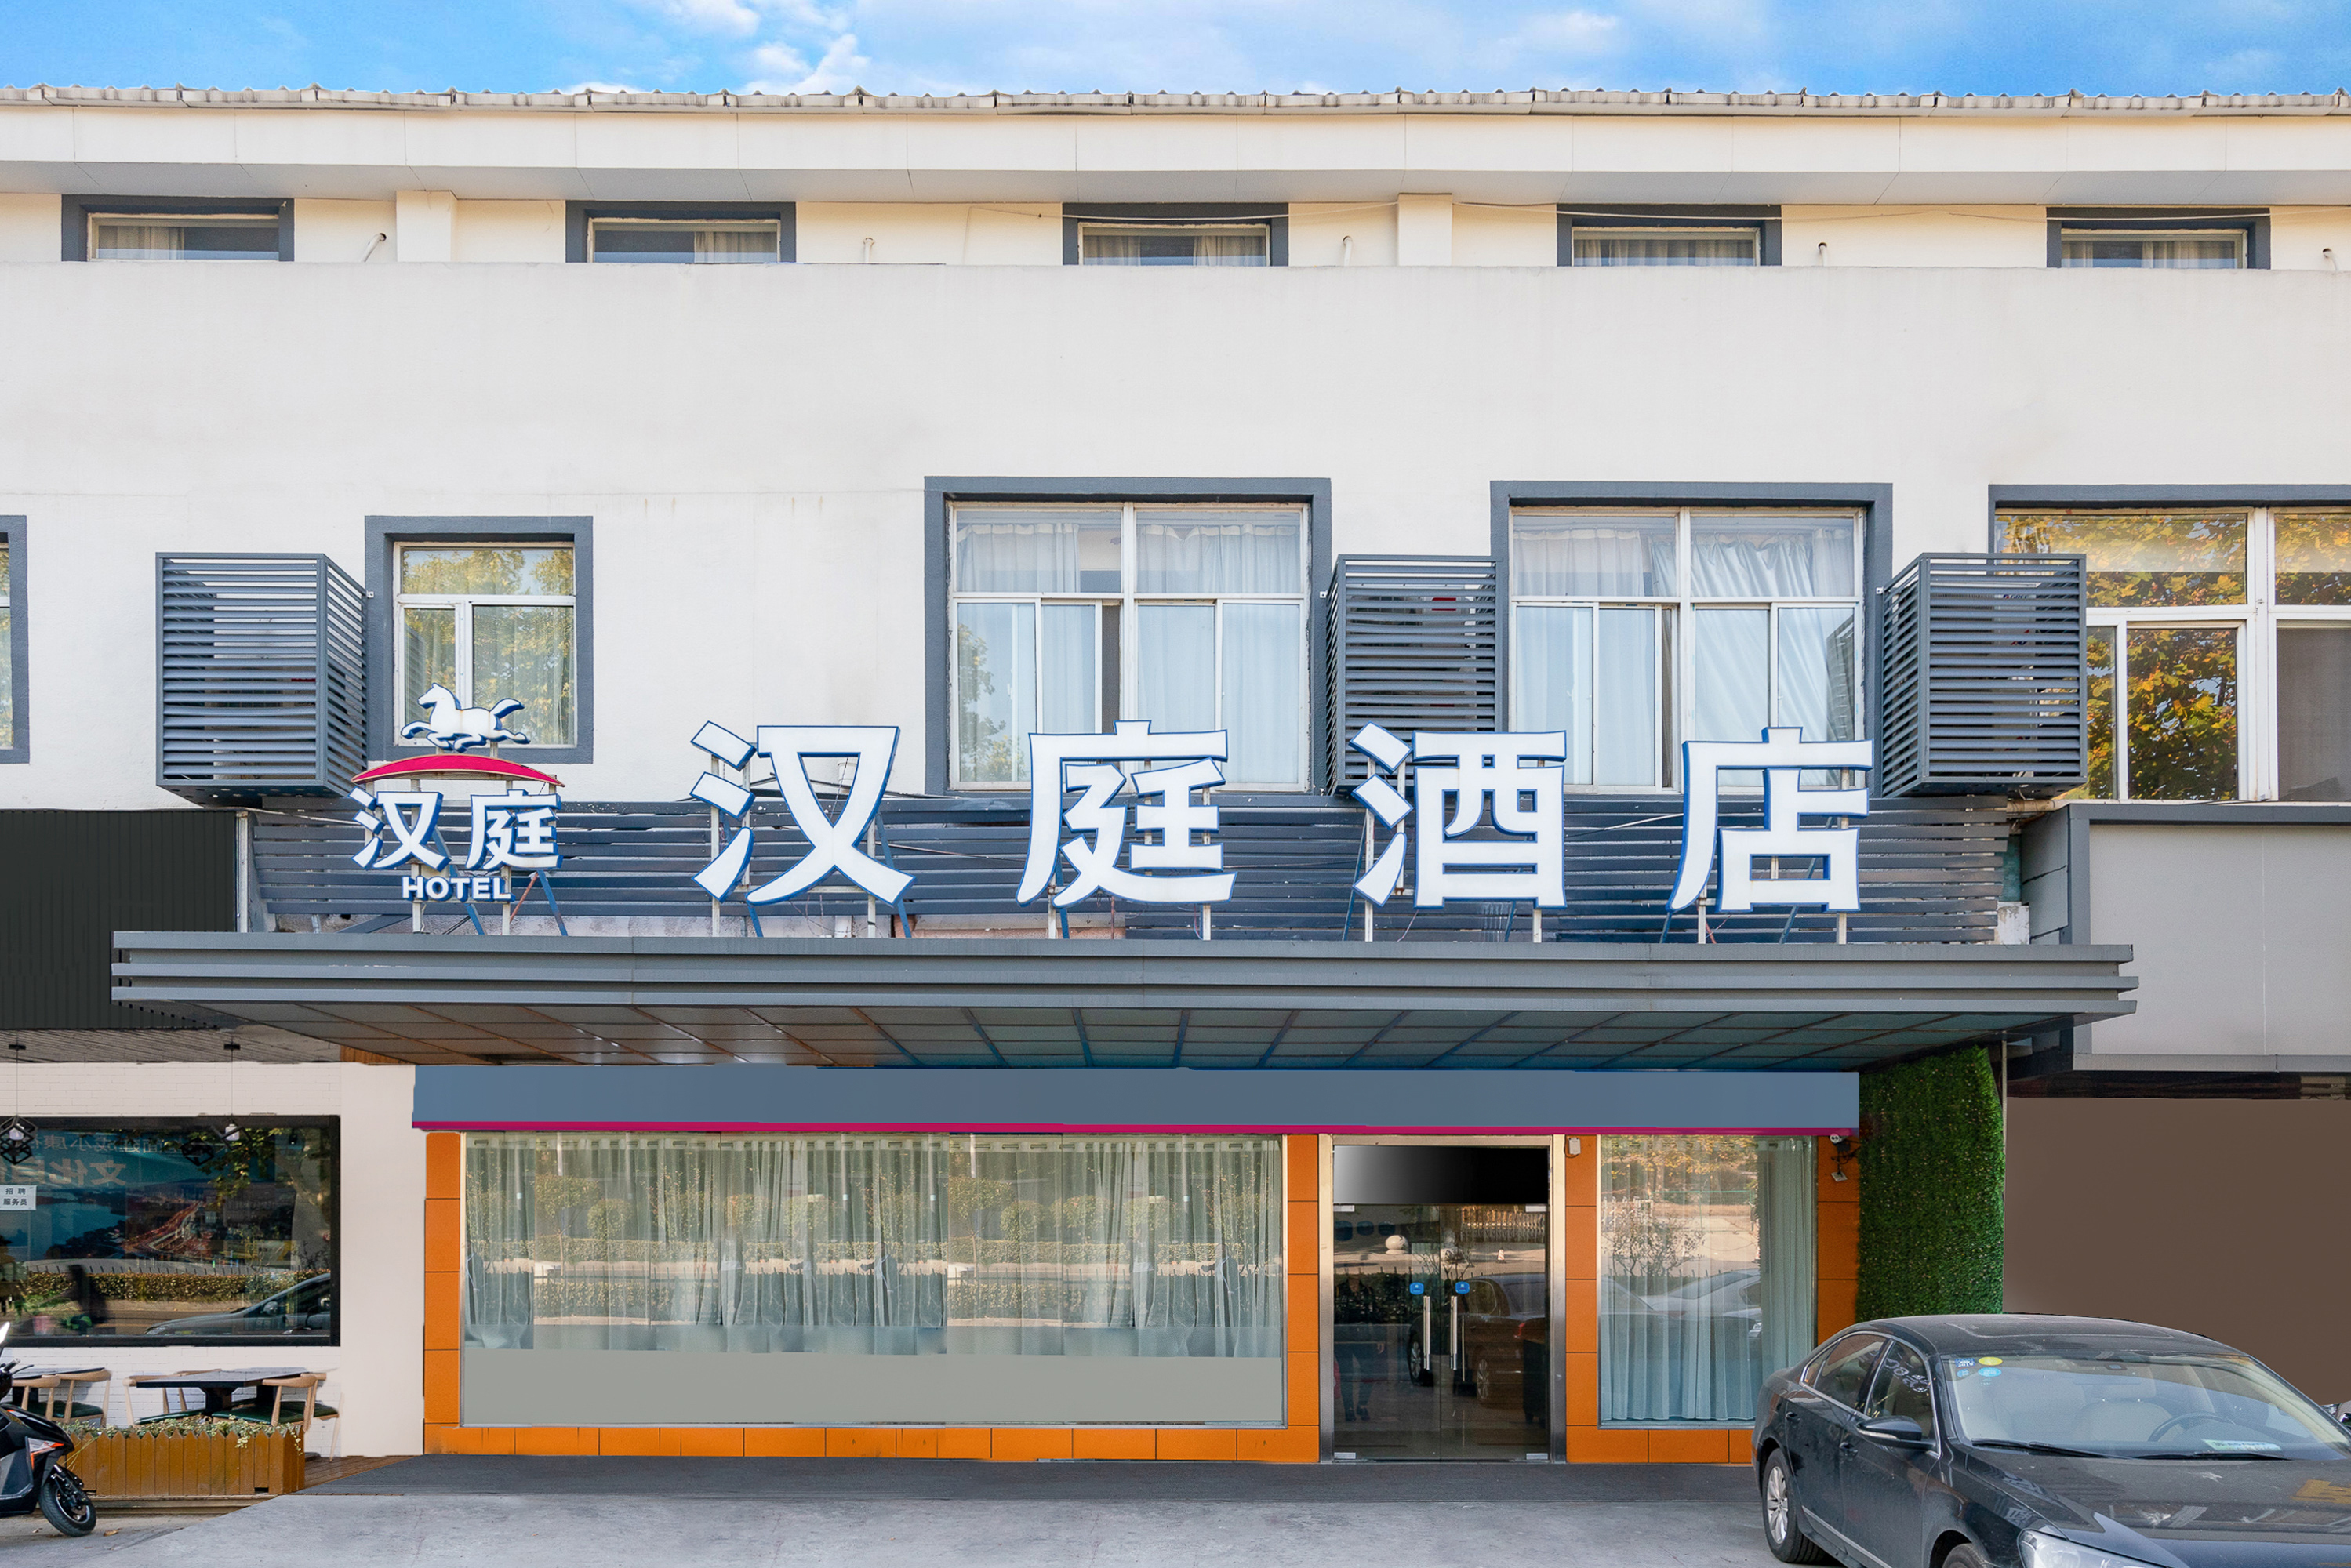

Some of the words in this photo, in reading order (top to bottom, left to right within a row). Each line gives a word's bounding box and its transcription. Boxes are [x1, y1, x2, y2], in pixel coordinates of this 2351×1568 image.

[348, 786, 563, 872] 汉庭
[690, 720, 1873, 913] 汉庭酒店
[402, 876, 515, 902] HOTEL
